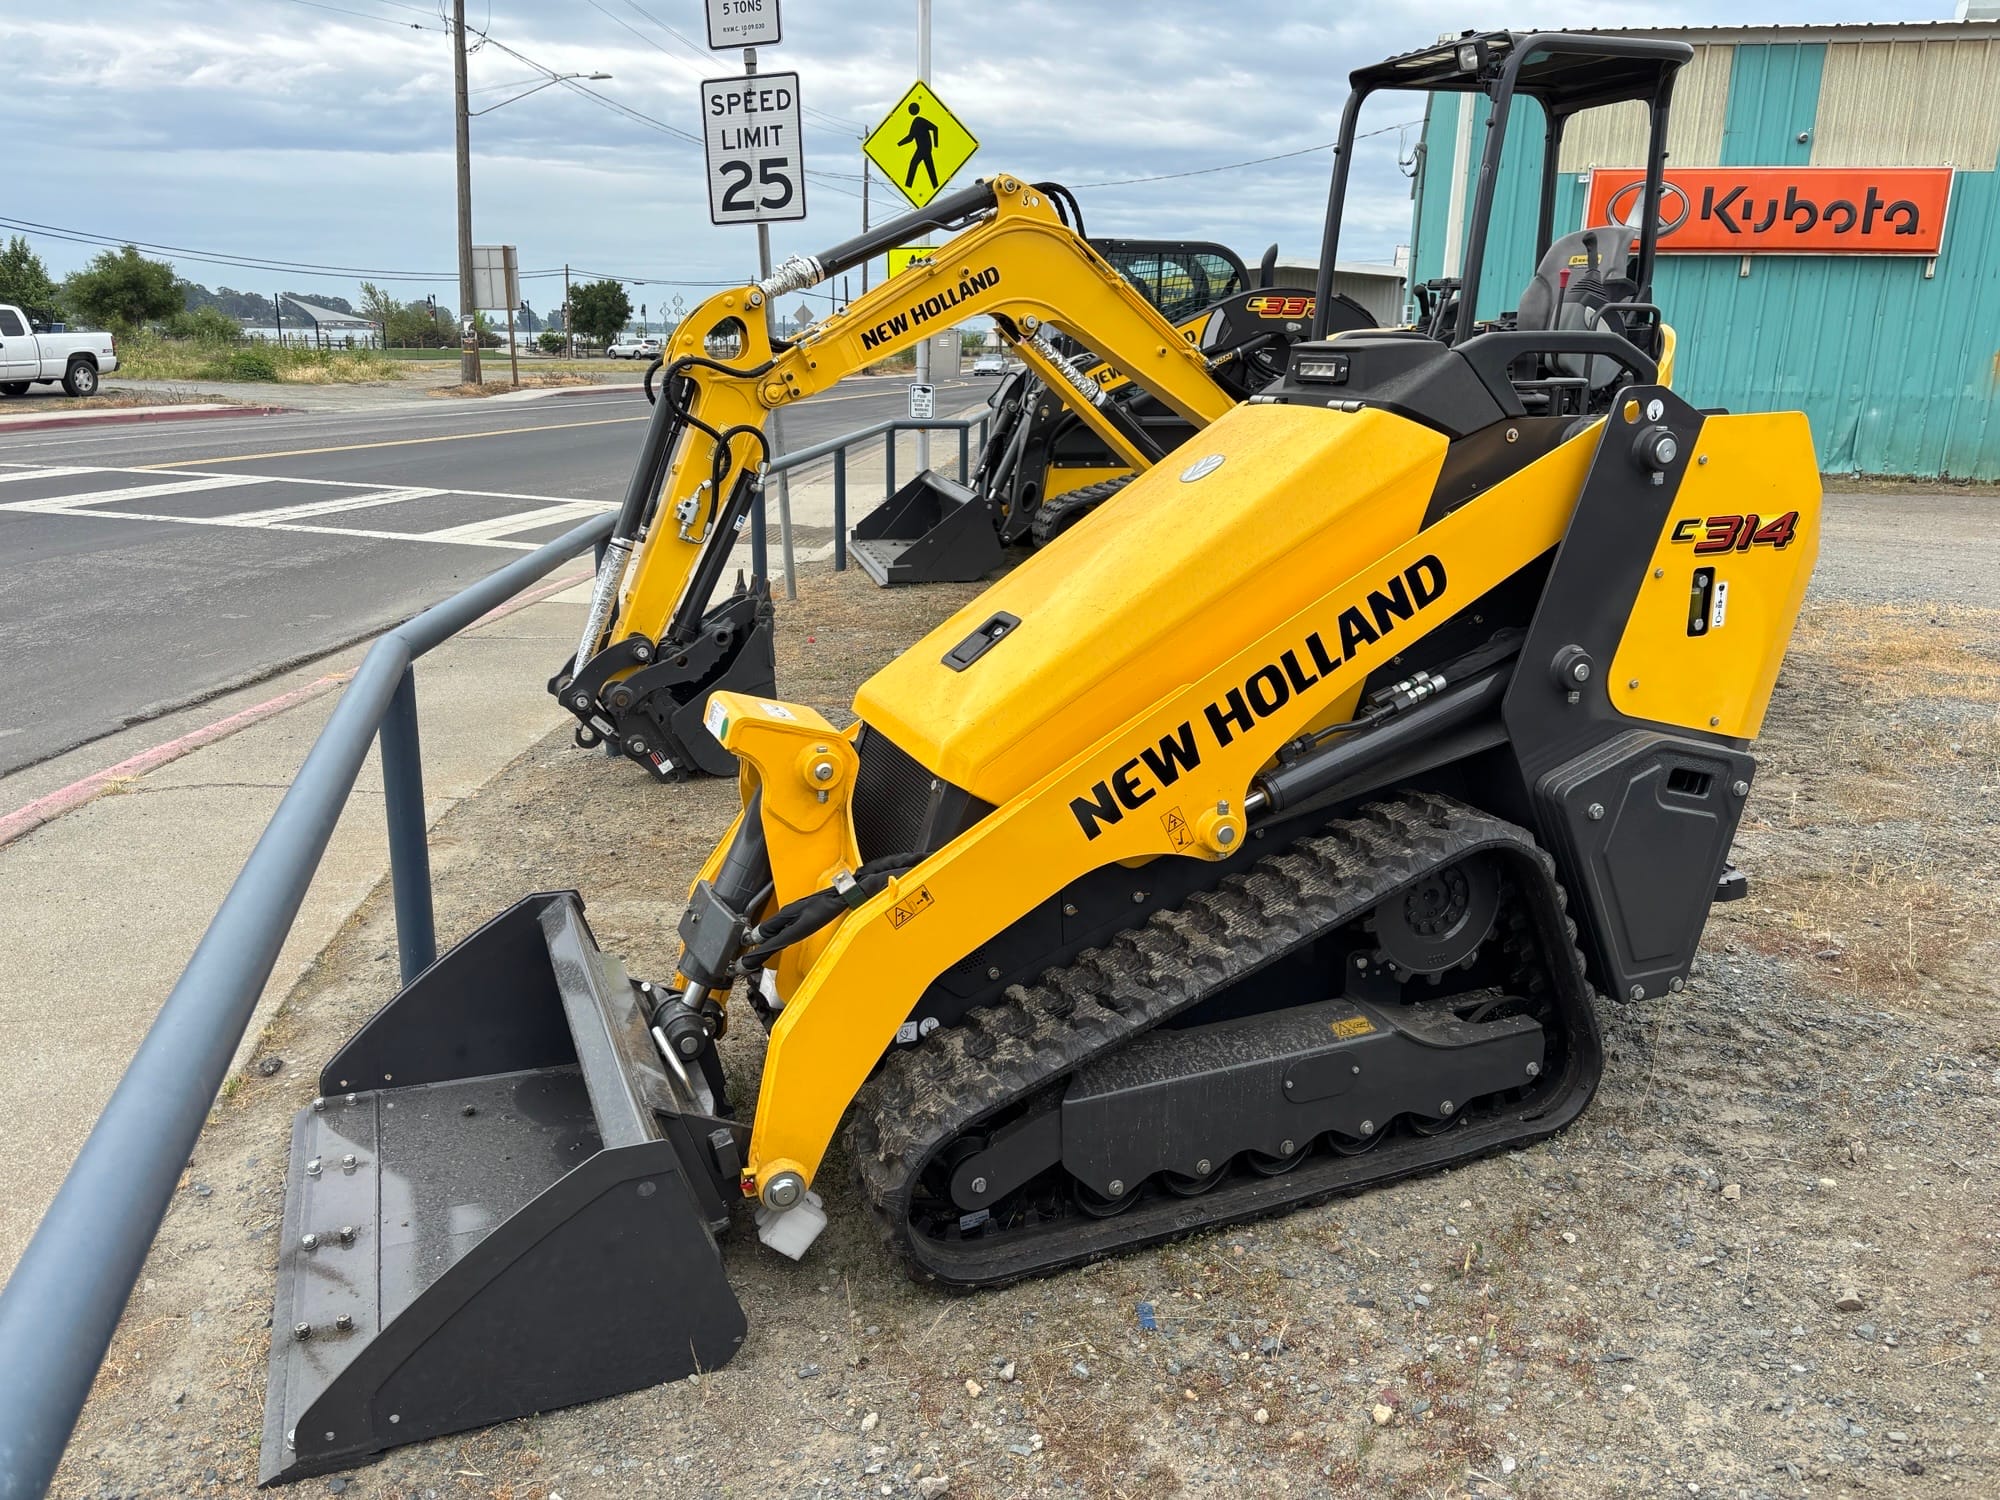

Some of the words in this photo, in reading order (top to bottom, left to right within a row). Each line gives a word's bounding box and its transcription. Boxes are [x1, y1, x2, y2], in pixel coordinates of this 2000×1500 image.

[723, 3, 730, 15] 5
[733, 0, 762, 14] TONS
[711, 89, 791, 116] SPEED
[722, 125, 783, 150] LIMIT
[719, 157, 793, 212] 25
[1701, 186, 1920, 235] Kubota
[860, 313, 909, 351] NEW
[910, 266, 1000, 326] HOLLAND
[1671, 511, 1799, 554] C314
[1068, 721, 1202, 842] NEW
[1203, 554, 1449, 749] HOLLAND
